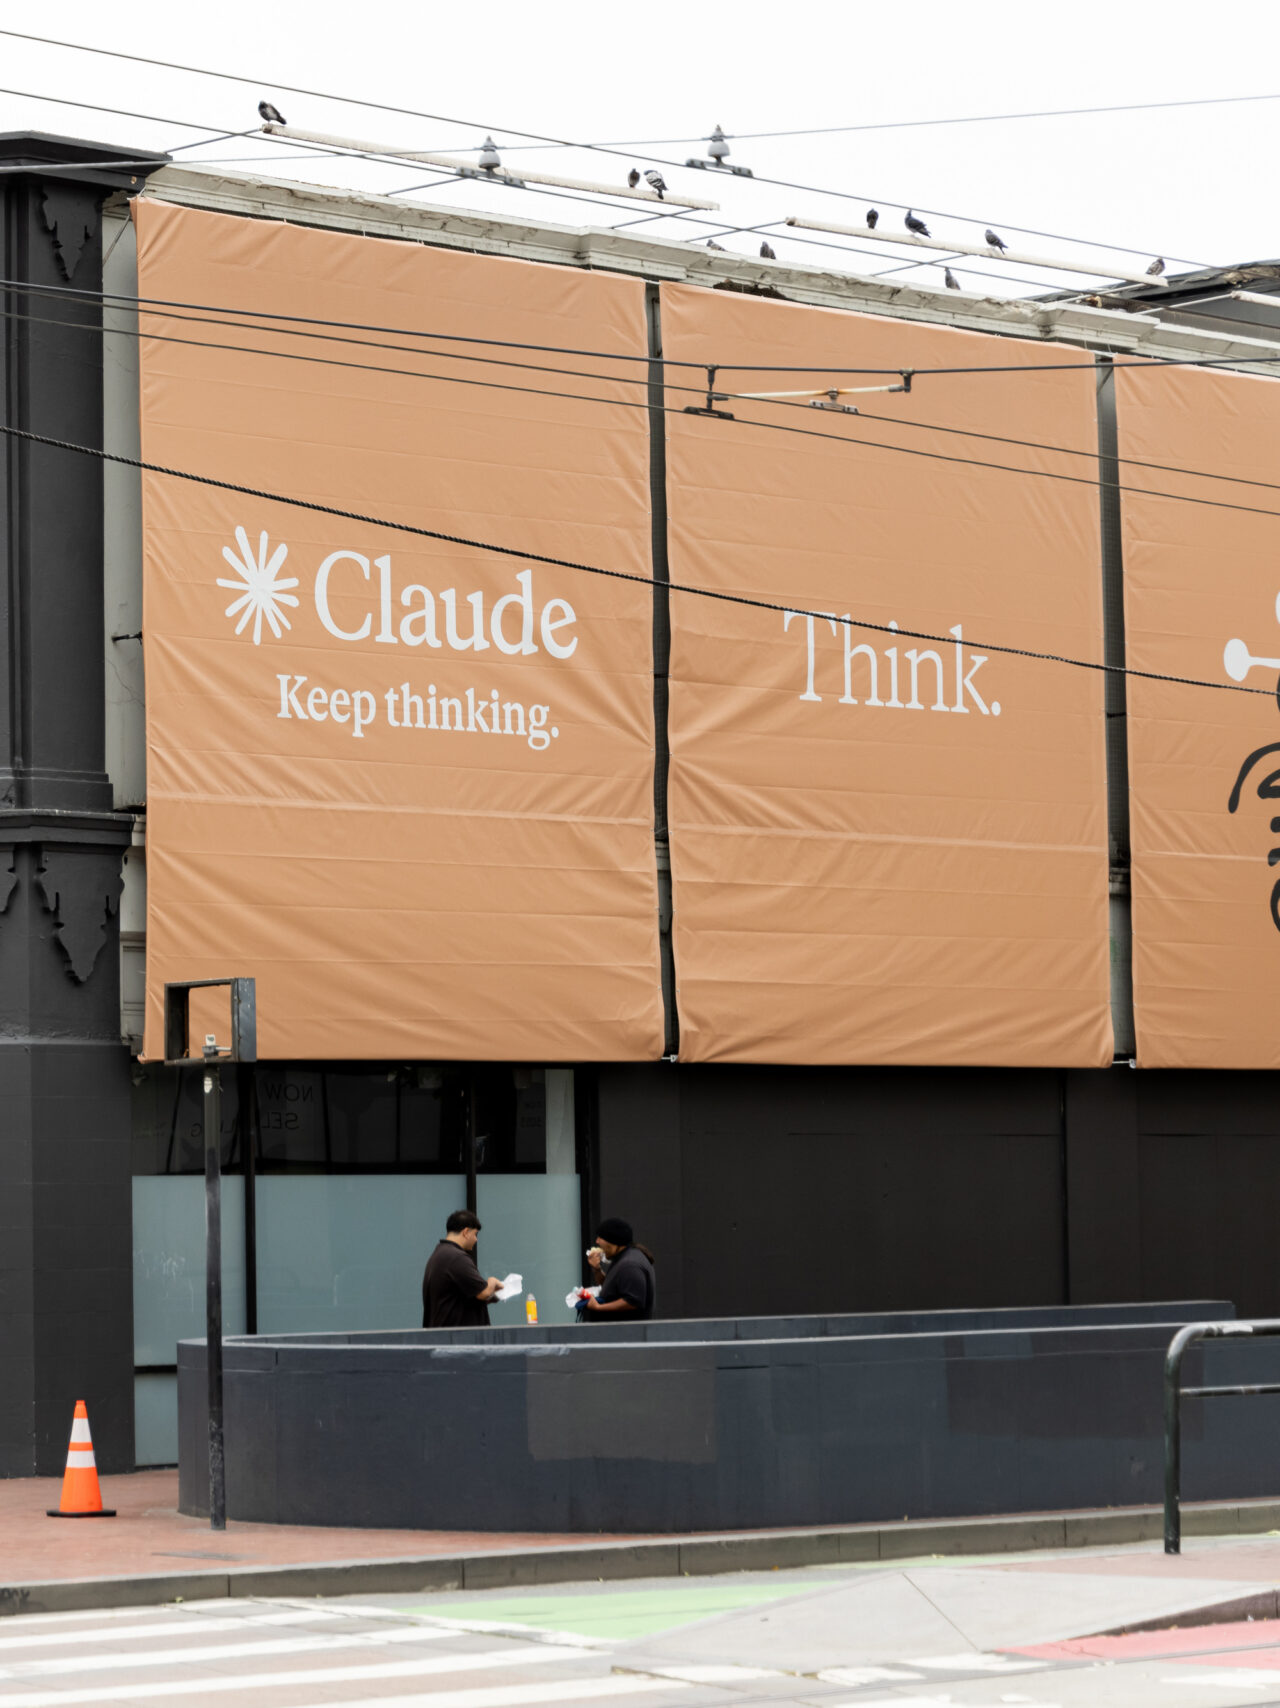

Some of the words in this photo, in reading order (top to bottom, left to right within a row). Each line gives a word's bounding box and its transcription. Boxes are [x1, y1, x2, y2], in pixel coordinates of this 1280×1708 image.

[314, 550, 579, 660] Claude
[276, 674, 377, 737] Keep
[384, 682, 560, 751] thinking.
[783, 610, 1001, 717] Think.
